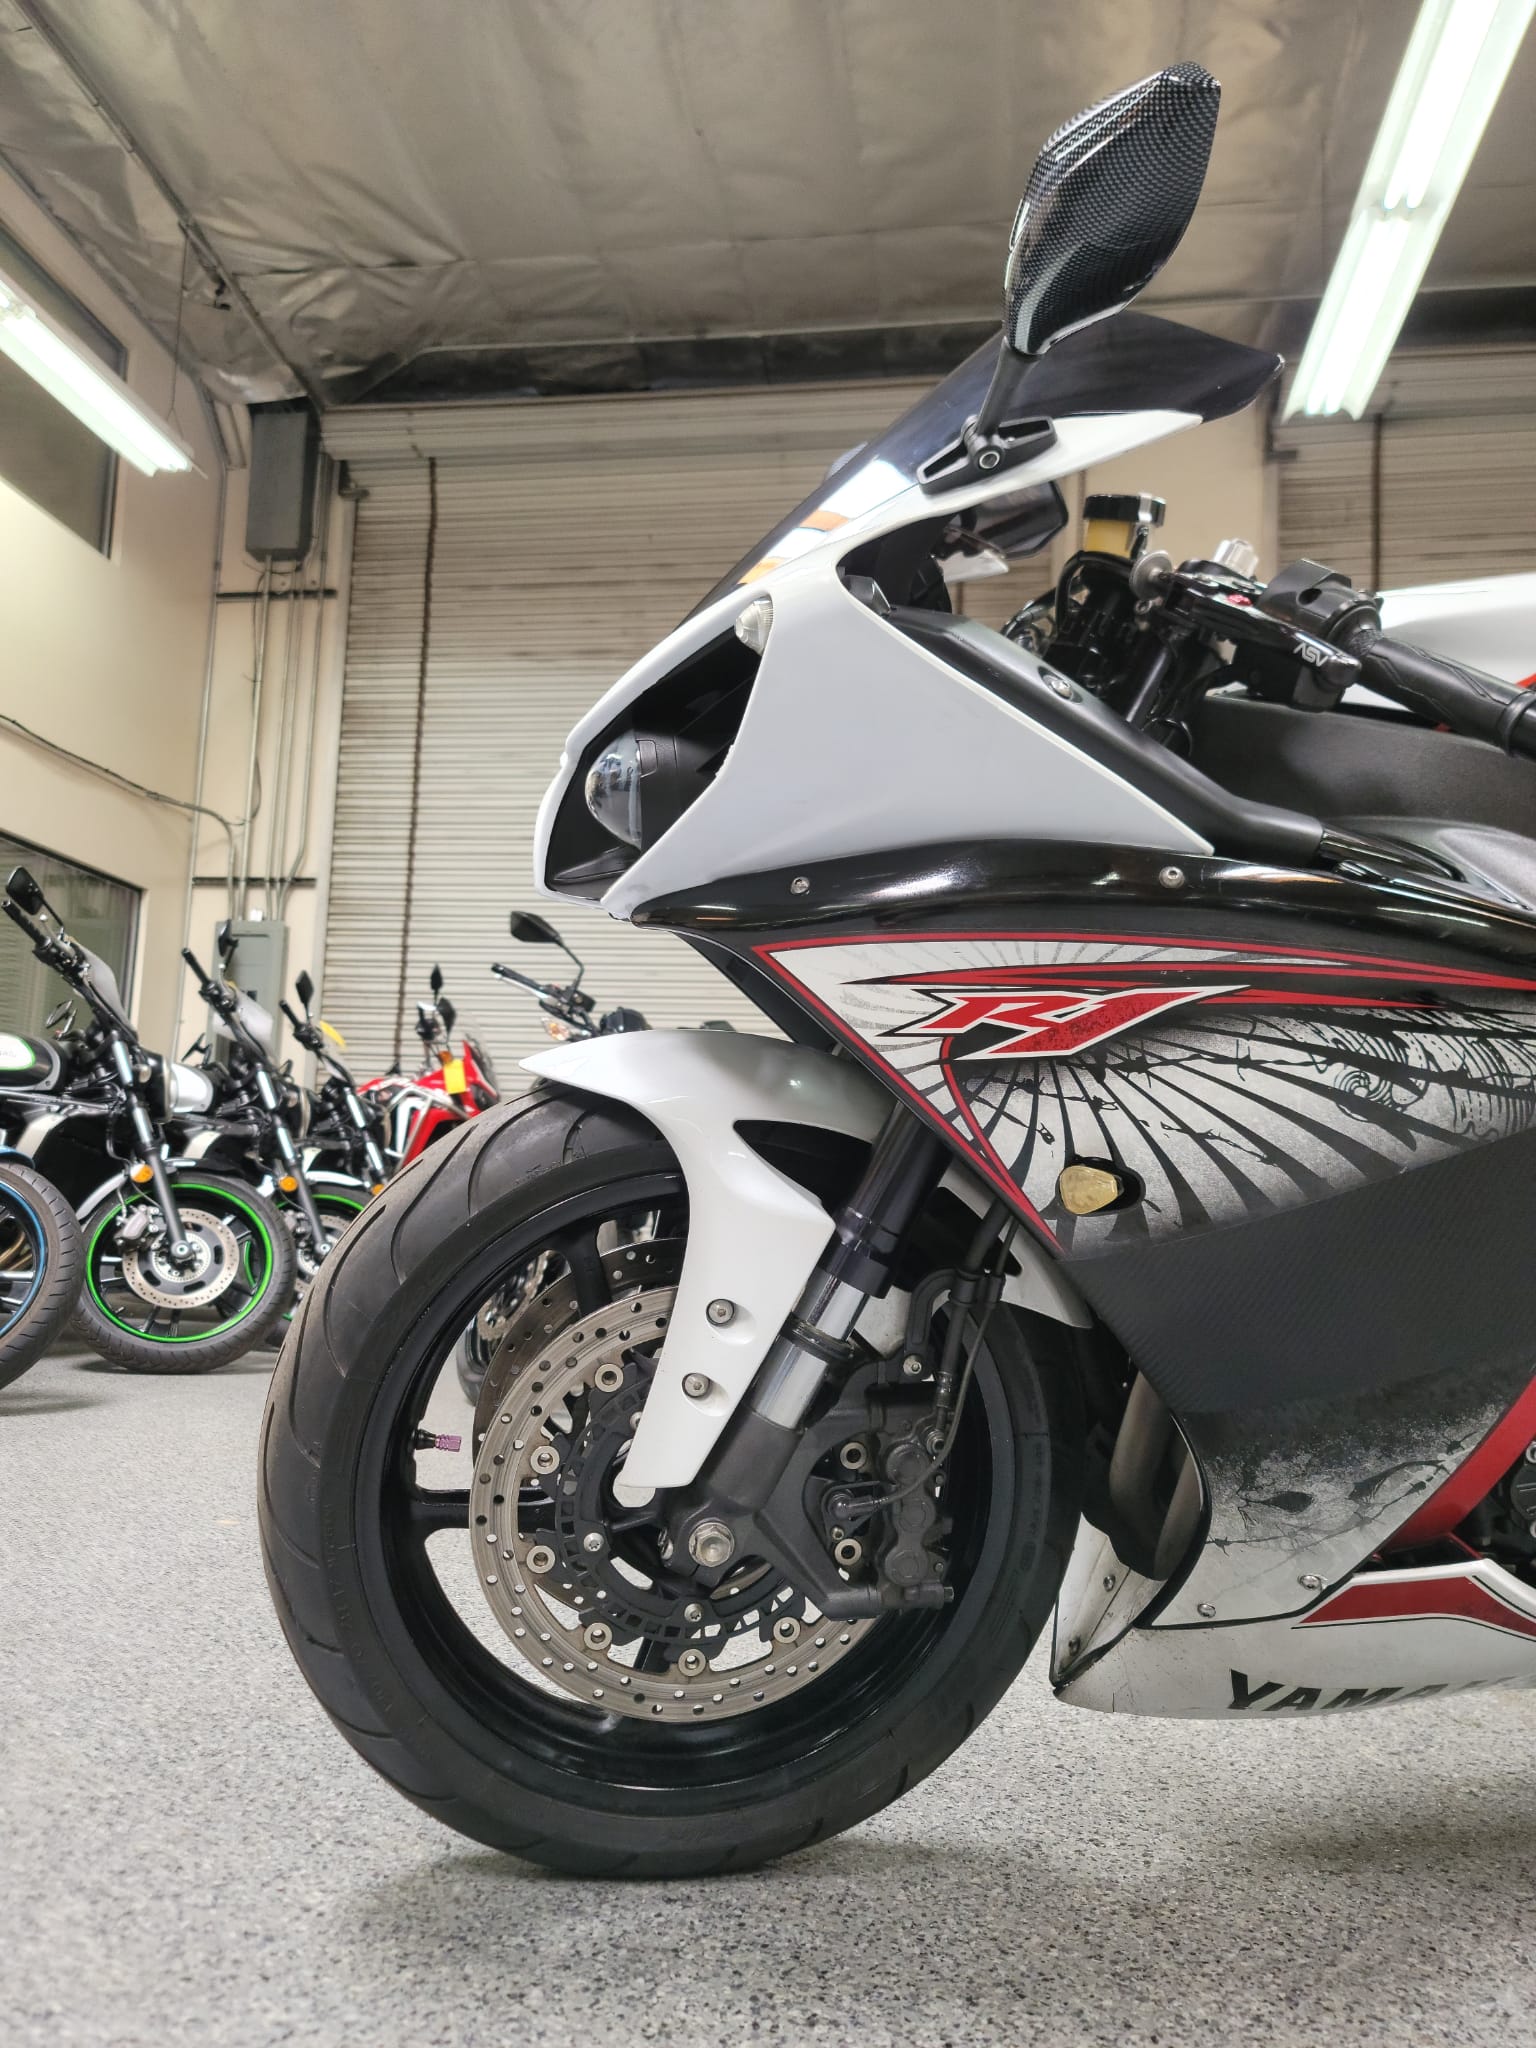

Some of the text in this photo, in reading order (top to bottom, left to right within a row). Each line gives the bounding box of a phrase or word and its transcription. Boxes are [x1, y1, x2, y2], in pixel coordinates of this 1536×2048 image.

[1293, 642, 1328, 667] ASV
[893, 984, 1251, 1060] R1
[1228, 1668, 1516, 1711] YAMA
